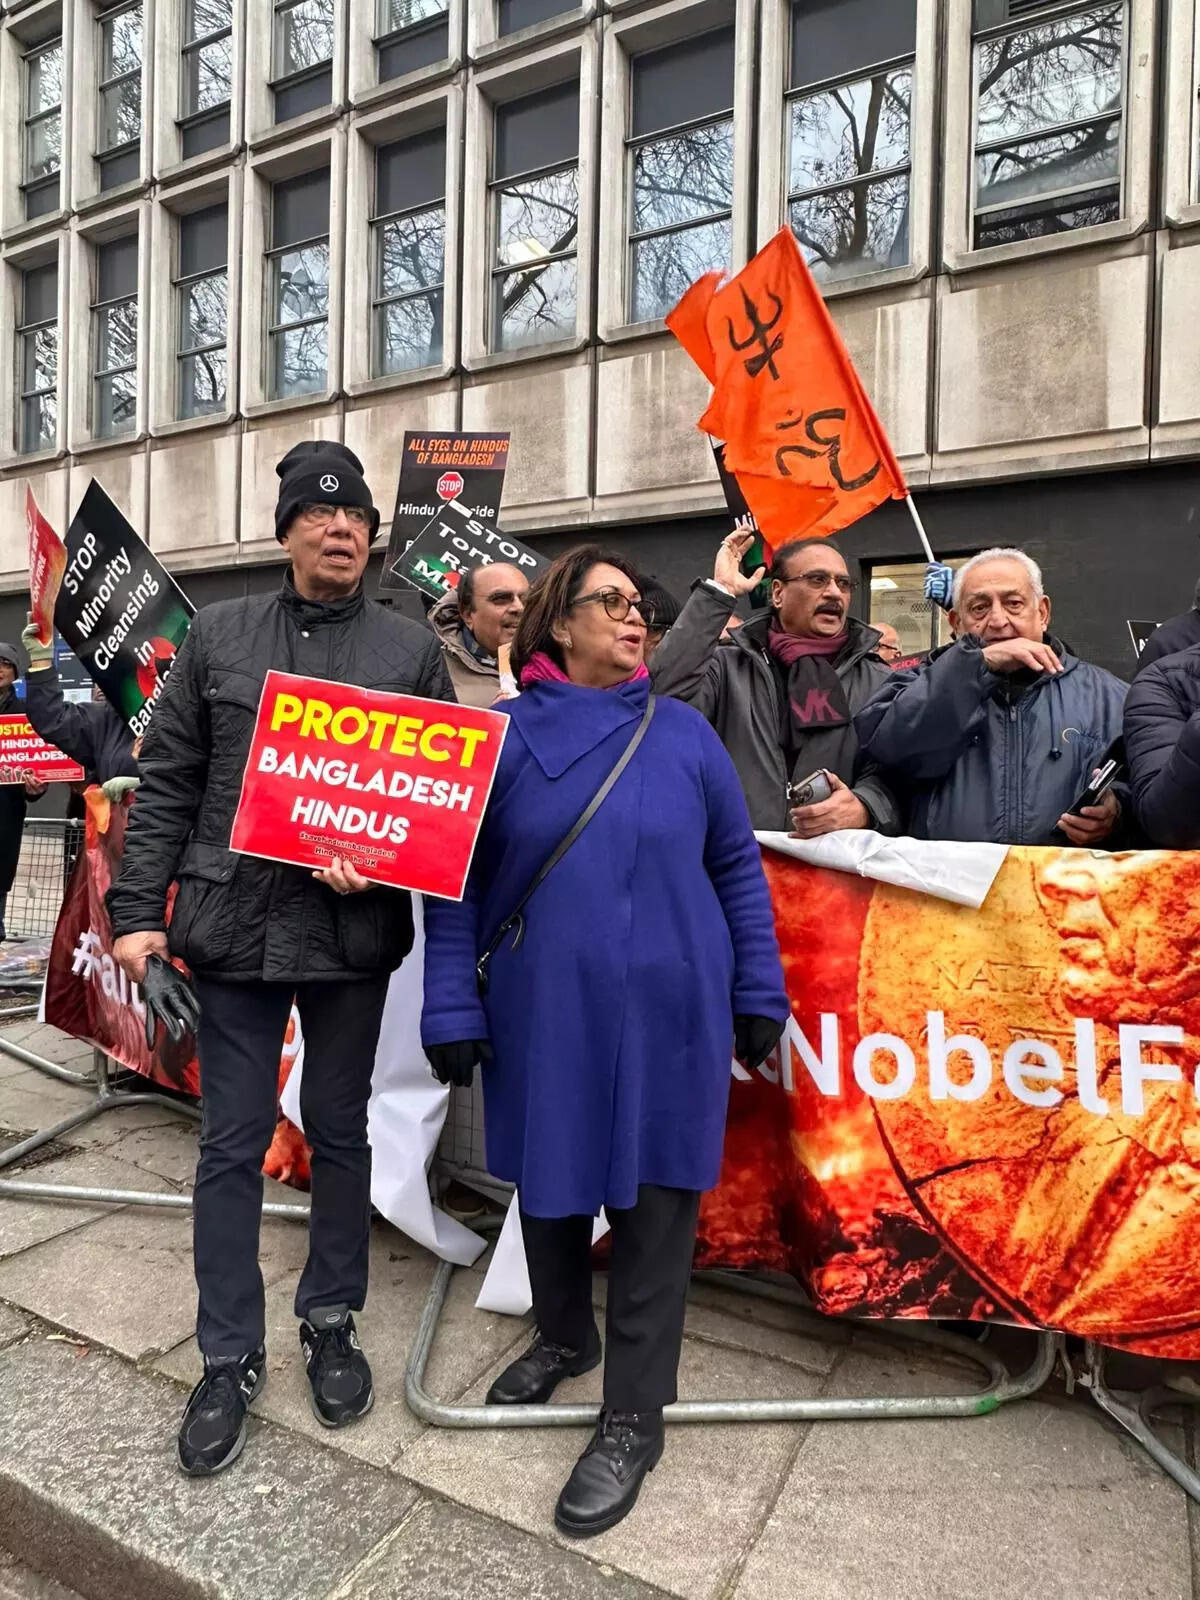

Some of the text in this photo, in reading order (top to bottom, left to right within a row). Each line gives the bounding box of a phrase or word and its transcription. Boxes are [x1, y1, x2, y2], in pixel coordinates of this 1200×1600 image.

[408, 438, 509, 452] ALL EYES ON HINDUS
[416, 452, 495, 465] OF BANGLADESH
[440, 480, 460, 491] STOP
[399, 503, 435, 516] Hindu
[438, 522, 495, 566] Tort
[465, 519, 537, 568] STOP
[64, 532, 97, 595] STOP
[75, 546, 132, 638] Minority
[94, 569, 159, 671] Cleansing
[134, 640, 155, 666] in
[0, 723, 35, 737] STIC
[1, 737, 45, 749] HINDUS
[270, 692, 488, 768] PROTECT
[0, 750, 71, 763] ANGLADES
[257, 746, 474, 812] BANGLADESH
[290, 796, 410, 844] HINDUS
[364, 857, 377, 867] UK
[731, 1010, 1200, 1116] NobelF
